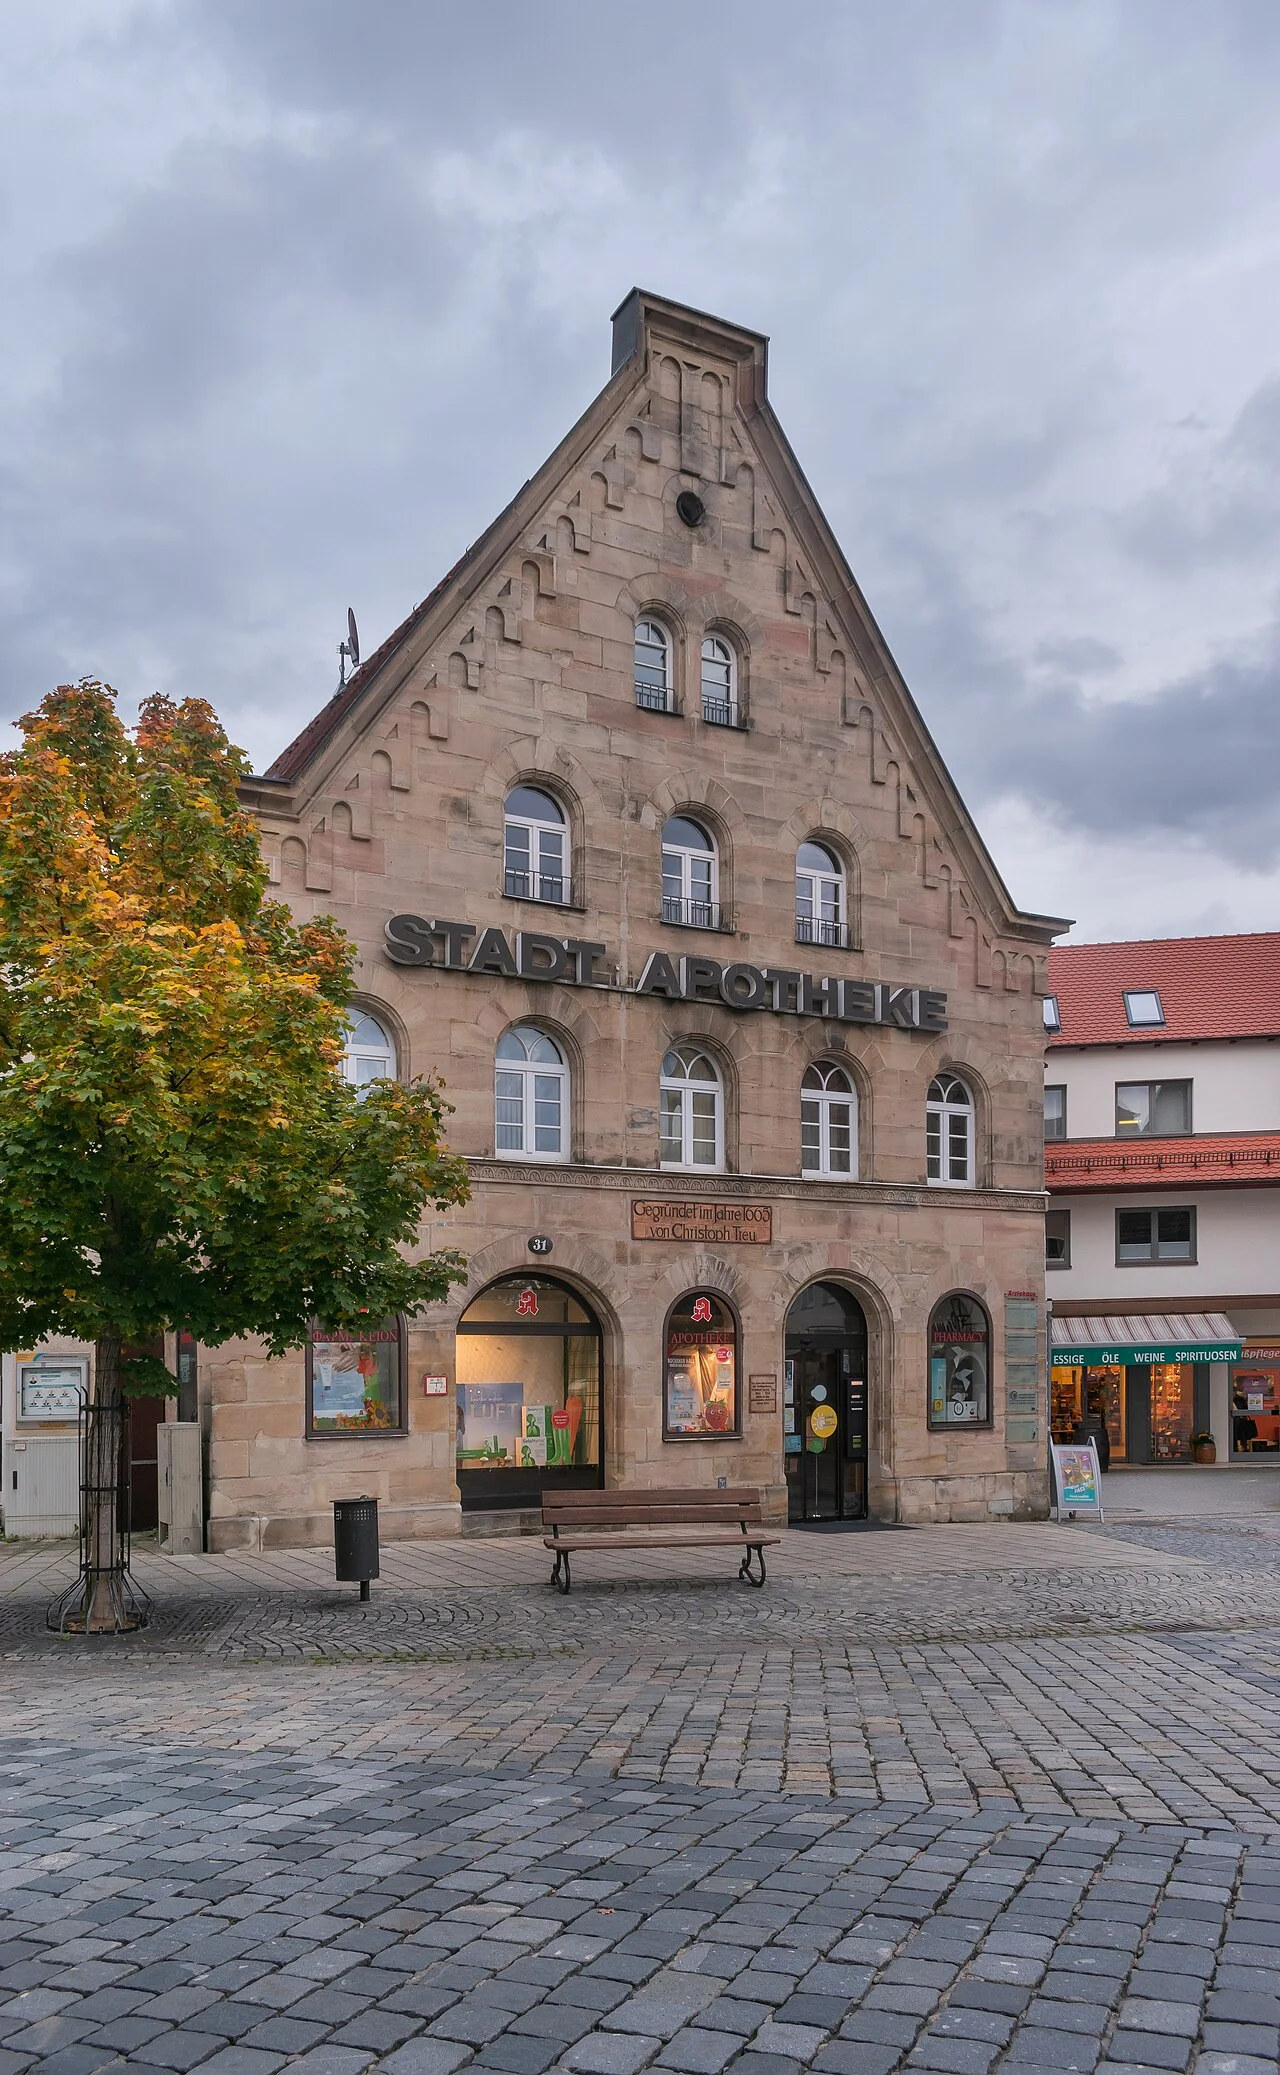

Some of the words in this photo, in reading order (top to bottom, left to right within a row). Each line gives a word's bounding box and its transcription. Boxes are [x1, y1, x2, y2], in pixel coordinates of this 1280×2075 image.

[383, 914, 606, 984] STADT
[636, 951, 949, 1031] APOTHEKE
[633, 1201, 698, 1223] Gegründet
[699, 1206, 713, 1220] im
[713, 1204, 742, 1223] Jahre
[743, 1206, 770, 1223] 1665
[649, 1226, 670, 1239] von
[671, 1223, 730, 1242] Christoph
[732, 1226, 757, 1242] Treu
[532, 1238, 548, 1251] 31
[671, 1332, 730, 1344] APOTHEKE
[934, 1332, 985, 1342] PHARMACY
[1053, 1354, 1085, 1365] ESSIGE
[1101, 1352, 1119, 1364] ÖLE
[1134, 1352, 1166, 1363] WEINE
[1175, 1350, 1237, 1362] SPIRITUOSEN
